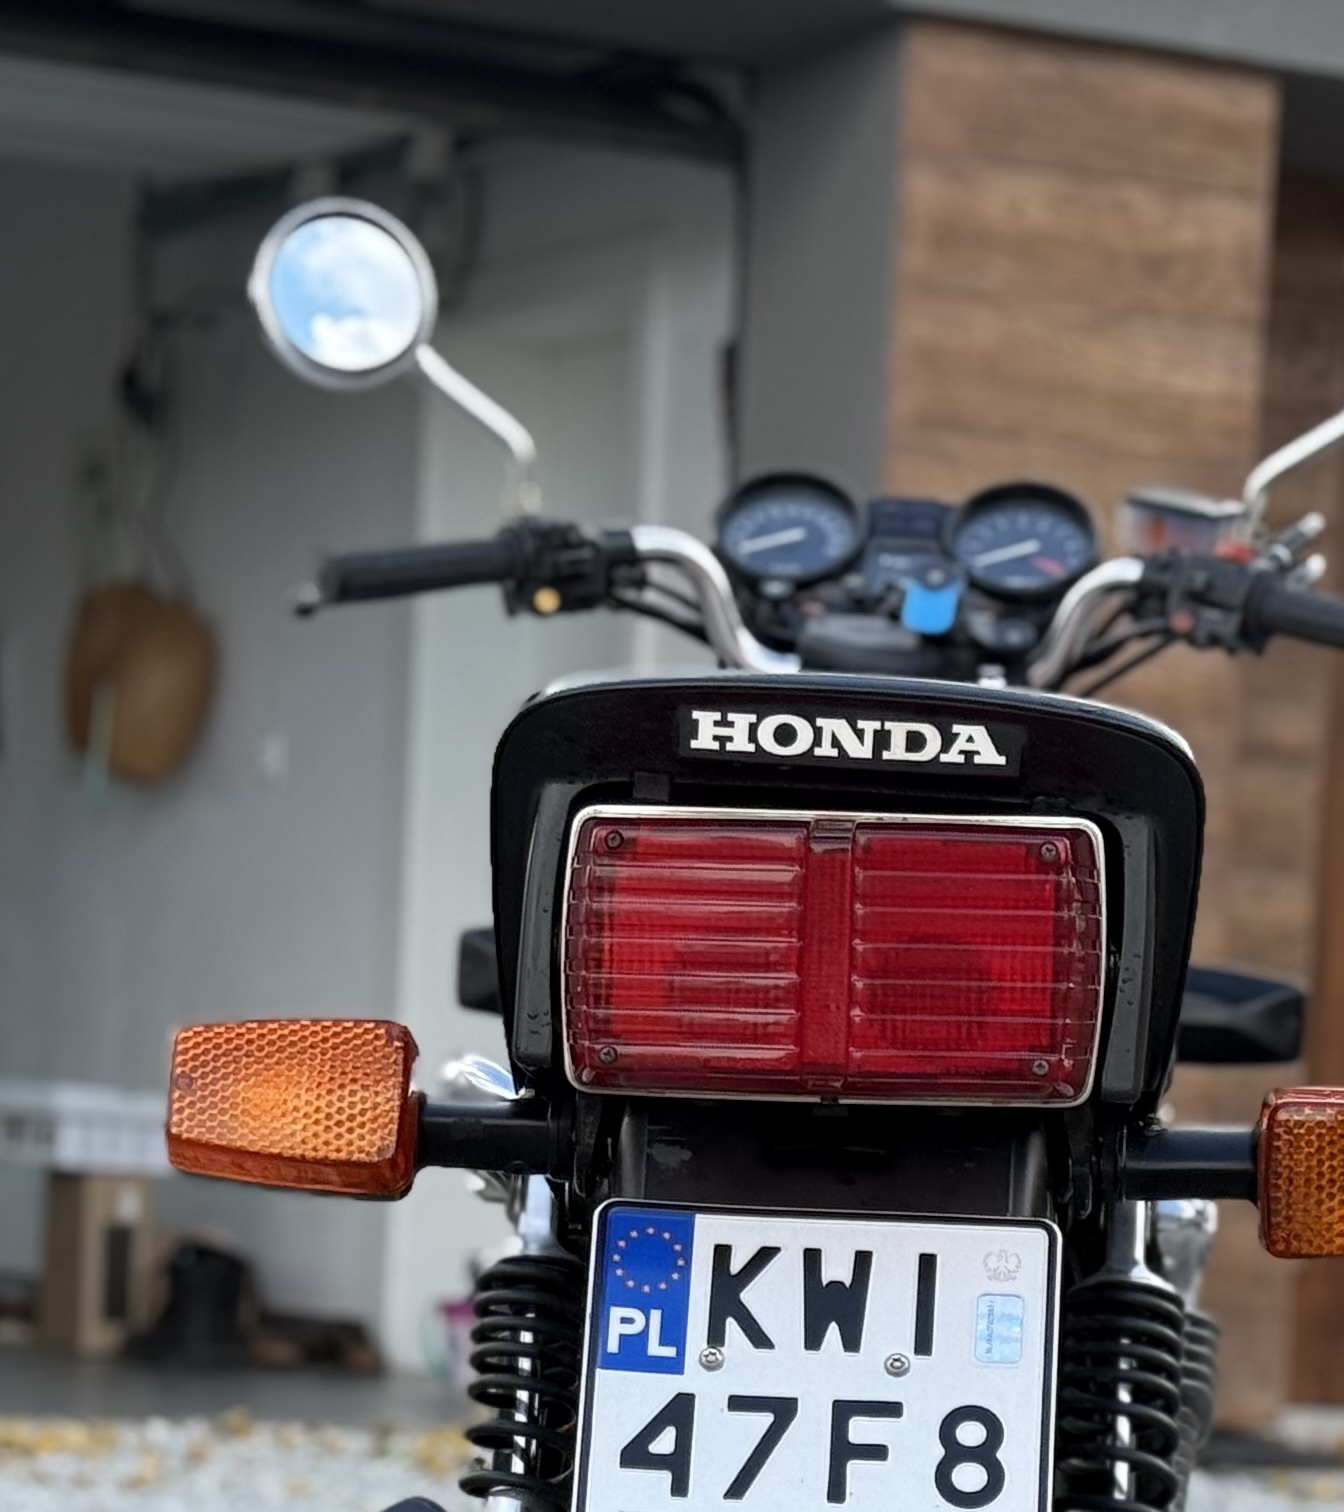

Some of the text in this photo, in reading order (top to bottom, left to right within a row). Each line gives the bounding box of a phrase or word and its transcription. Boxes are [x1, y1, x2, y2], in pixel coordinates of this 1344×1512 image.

[690, 710, 1007, 766] HONDA
[605, 1305, 677, 1358] PL
[706, 1243, 938, 1357] KWI
[619, 1391, 1006, 1509] 47F8
